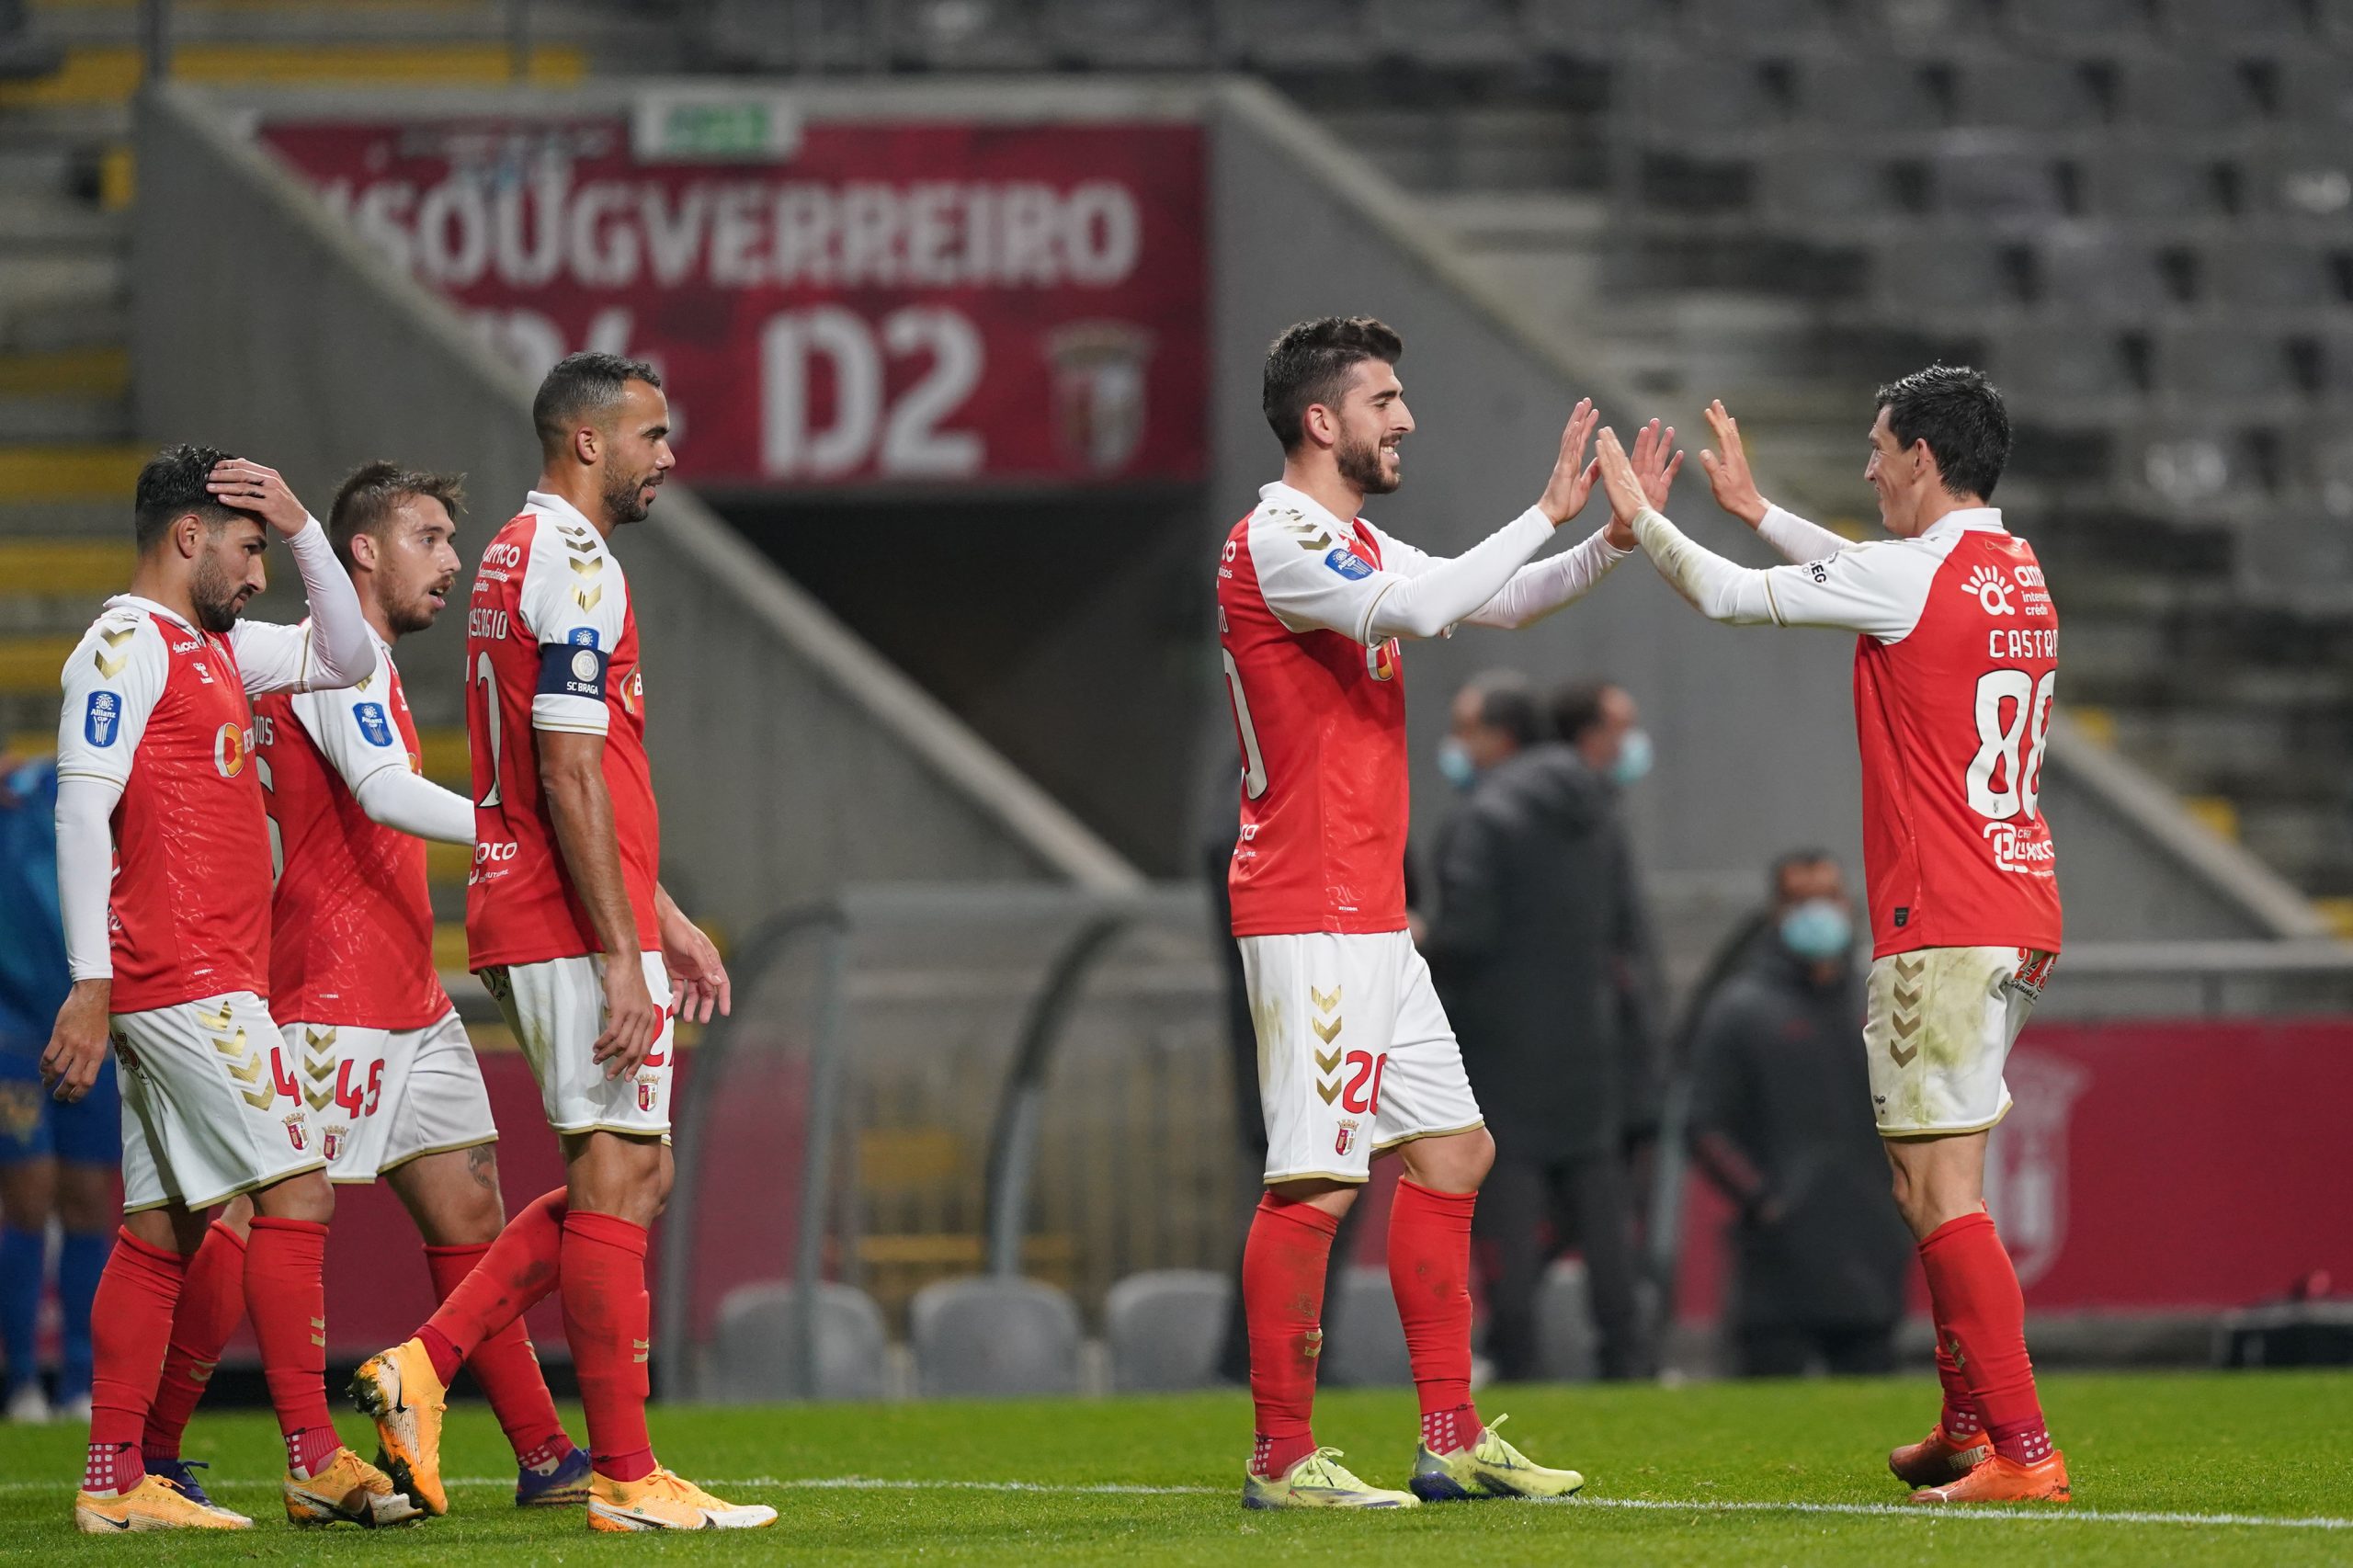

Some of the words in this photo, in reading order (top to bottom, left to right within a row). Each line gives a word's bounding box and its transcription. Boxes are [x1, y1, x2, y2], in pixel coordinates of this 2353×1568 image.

[759, 304, 984, 478] D2
[566, 681, 578, 691] SC
[577, 682, 599, 696] BRAGA
[90, 708, 116, 719] Allianz
[335, 1058, 386, 1120] 45
